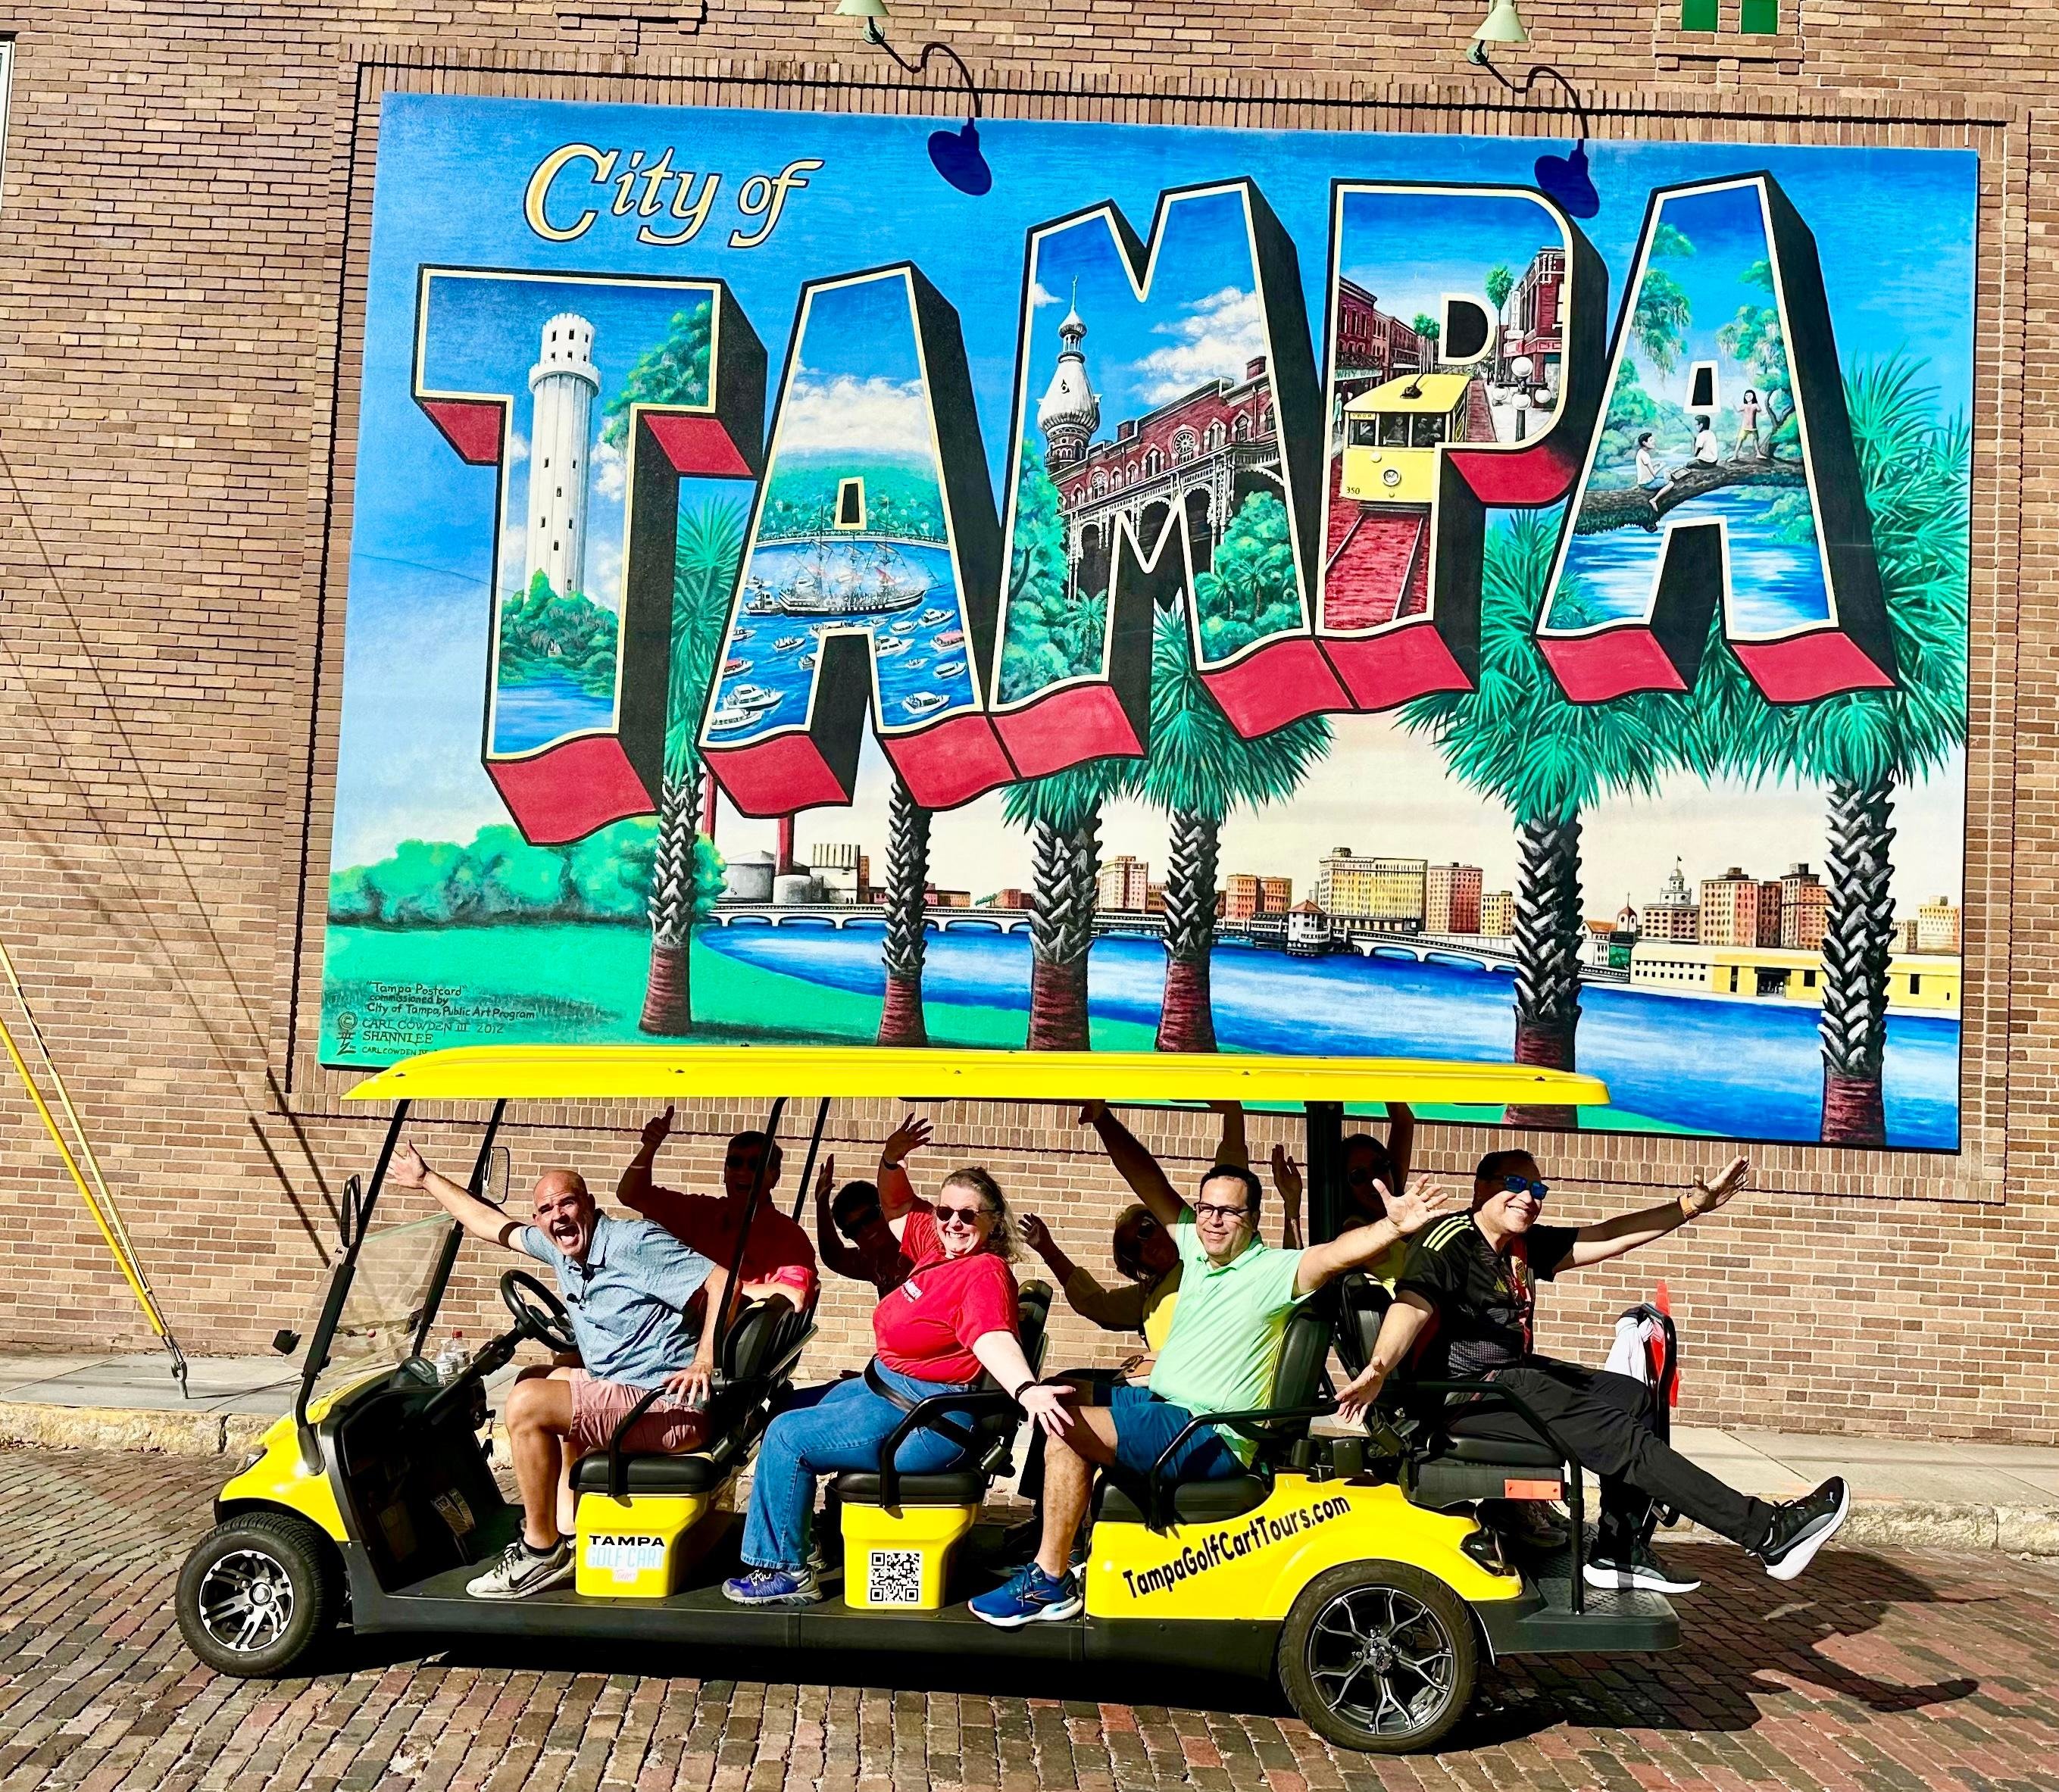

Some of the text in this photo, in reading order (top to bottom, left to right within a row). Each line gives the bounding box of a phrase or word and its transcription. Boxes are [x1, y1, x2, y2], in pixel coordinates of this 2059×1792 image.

[523, 142, 826, 249] City of
[1346, 486, 1361, 495] 350
[412, 170, 1900, 847] TAMPA
[370, 994, 448, 1007] commissioned by
[367, 1003, 535, 1021] City of Tampa, Public Art Program
[362, 1019, 398, 1031] CARL
[398, 1019, 451, 1036] COWDEN
[455, 1021, 470, 1032] III
[477, 1023, 505, 1034] 2012
[589, 1534, 665, 1547] TAMPA
[1122, 1495, 1352, 1598] TampaGolfCartTours.com
[588, 1547, 664, 1568] GOLF CART
